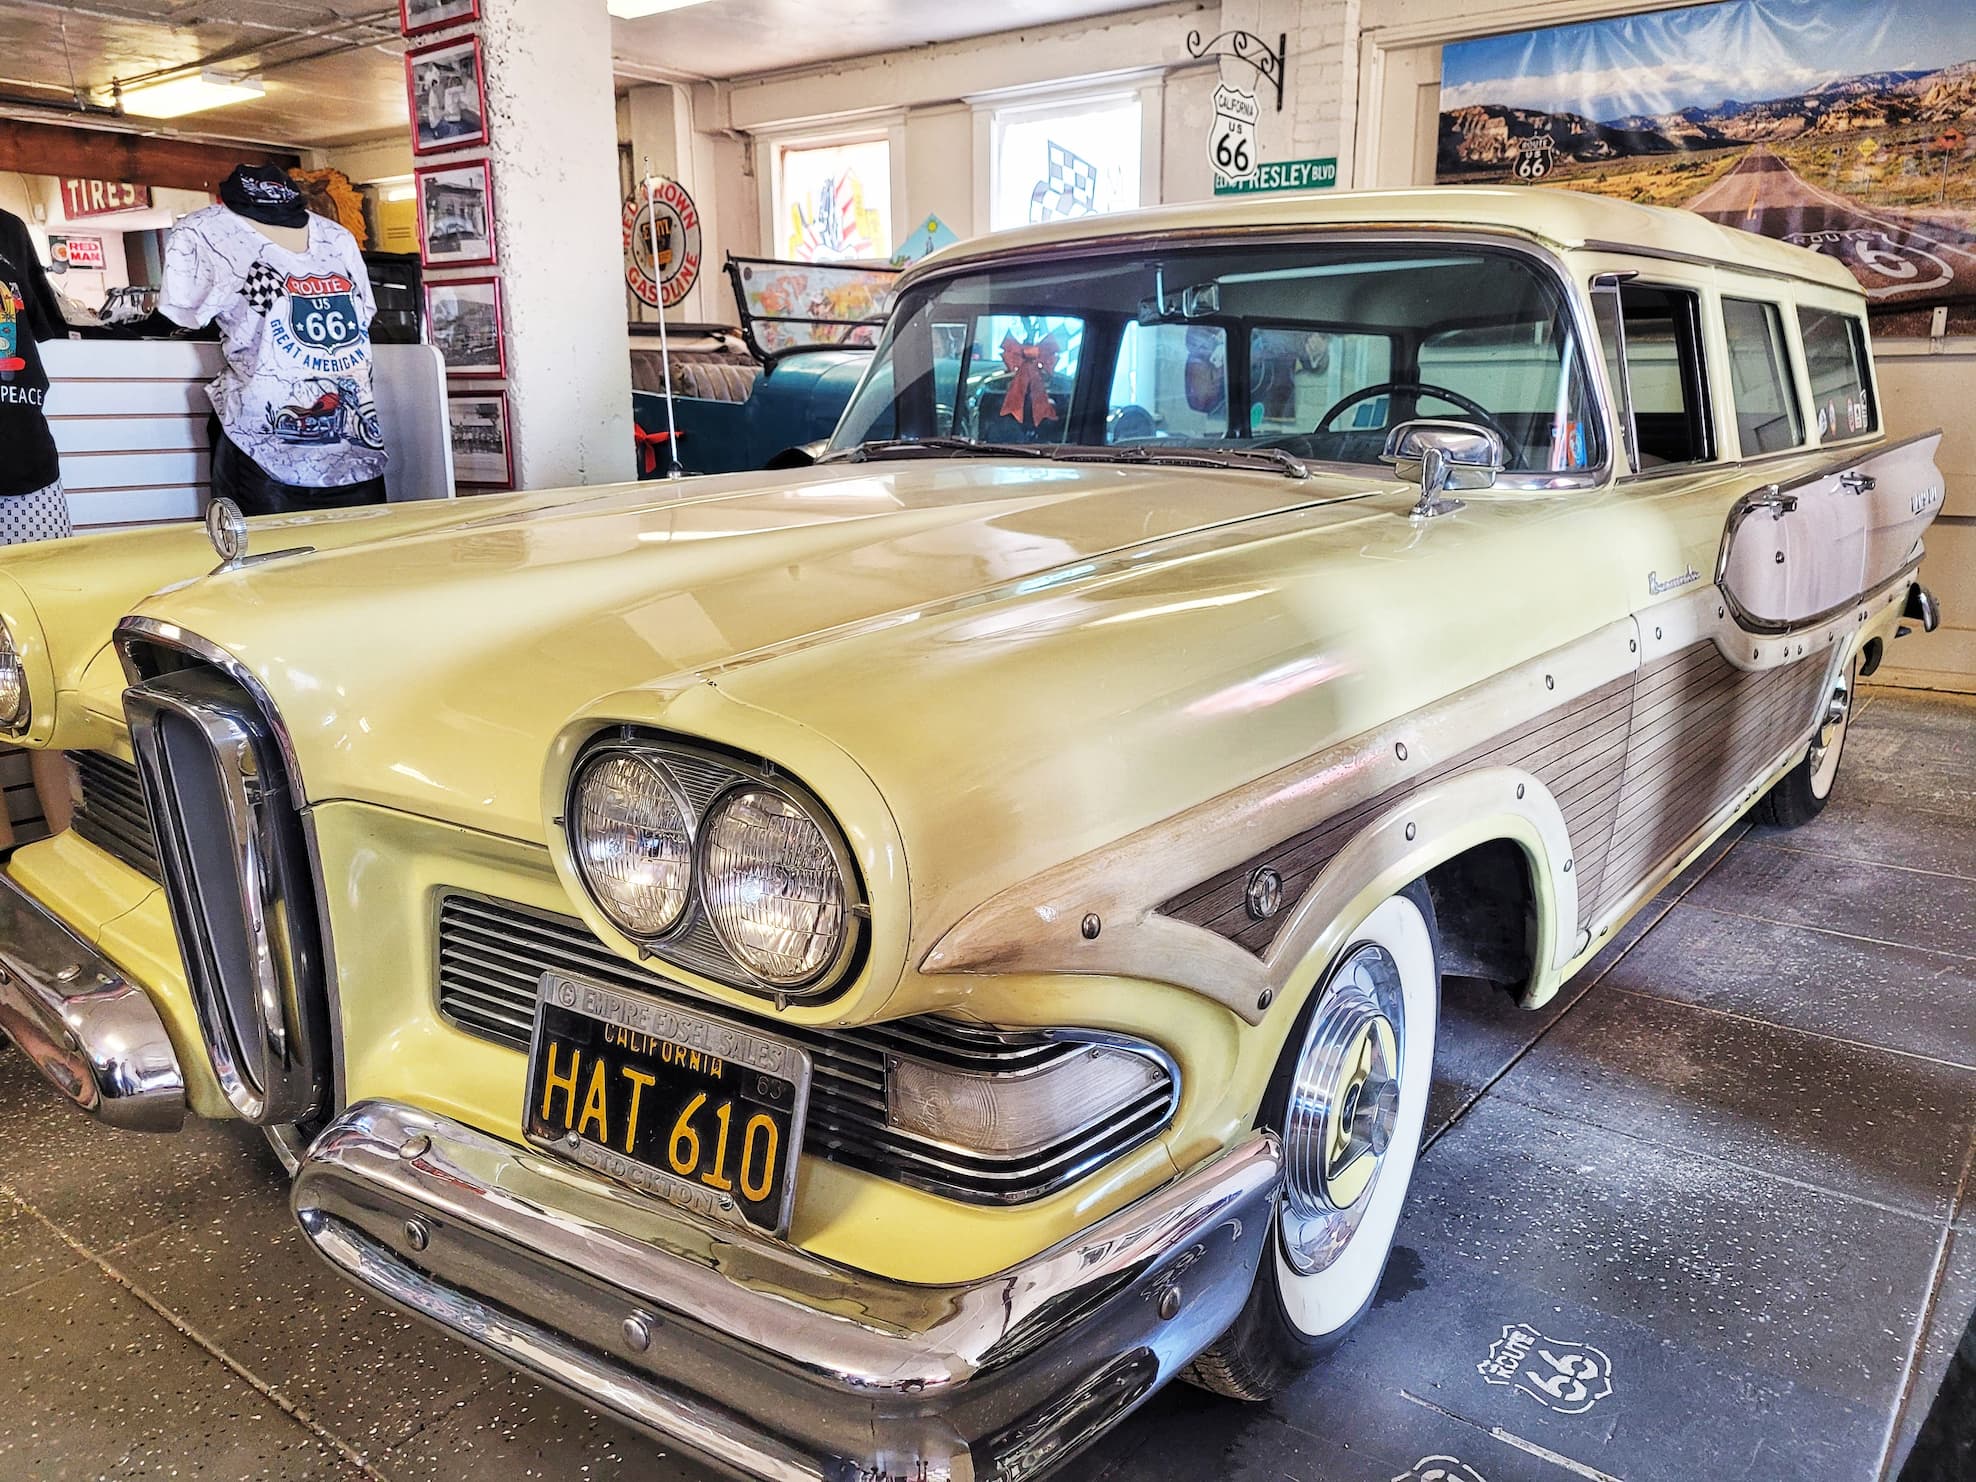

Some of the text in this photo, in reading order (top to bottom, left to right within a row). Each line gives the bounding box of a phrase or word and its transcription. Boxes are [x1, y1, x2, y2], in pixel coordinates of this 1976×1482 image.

[1219, 94, 1254, 116] CALIFORNIA
[1228, 122, 1243, 134] US
[1216, 133, 1249, 171] 66
[1519, 158, 1545, 177] 66
[1239, 163, 1313, 190] RESLEY
[1311, 164, 1336, 181] BLVD
[67, 179, 135, 213] TIRES
[622, 201, 639, 247] RED
[1793, 231, 1876, 245] ROUTE
[69, 242, 98, 251] RED
[71, 252, 101, 261] MAN
[292, 279, 343, 294] ROUTE
[628, 251, 698, 303] GASOLINE
[311, 298, 331, 310] US
[306, 311, 347, 342] 66
[270, 319, 365, 372] GREAT AMERICAN
[1, 385, 43, 406] PEACE
[582, 990, 650, 1027] EMPIRE
[654, 1011, 710, 1047] EDSEL
[717, 1030, 783, 1073] SALES
[604, 1022, 723, 1080] CALIFORNIA
[541, 1042, 779, 1202] HAT 610
[581, 1147, 716, 1213] STOCKTON
[1491, 1329, 1536, 1380] ROUTE
[1525, 1349, 1600, 1402] 66
